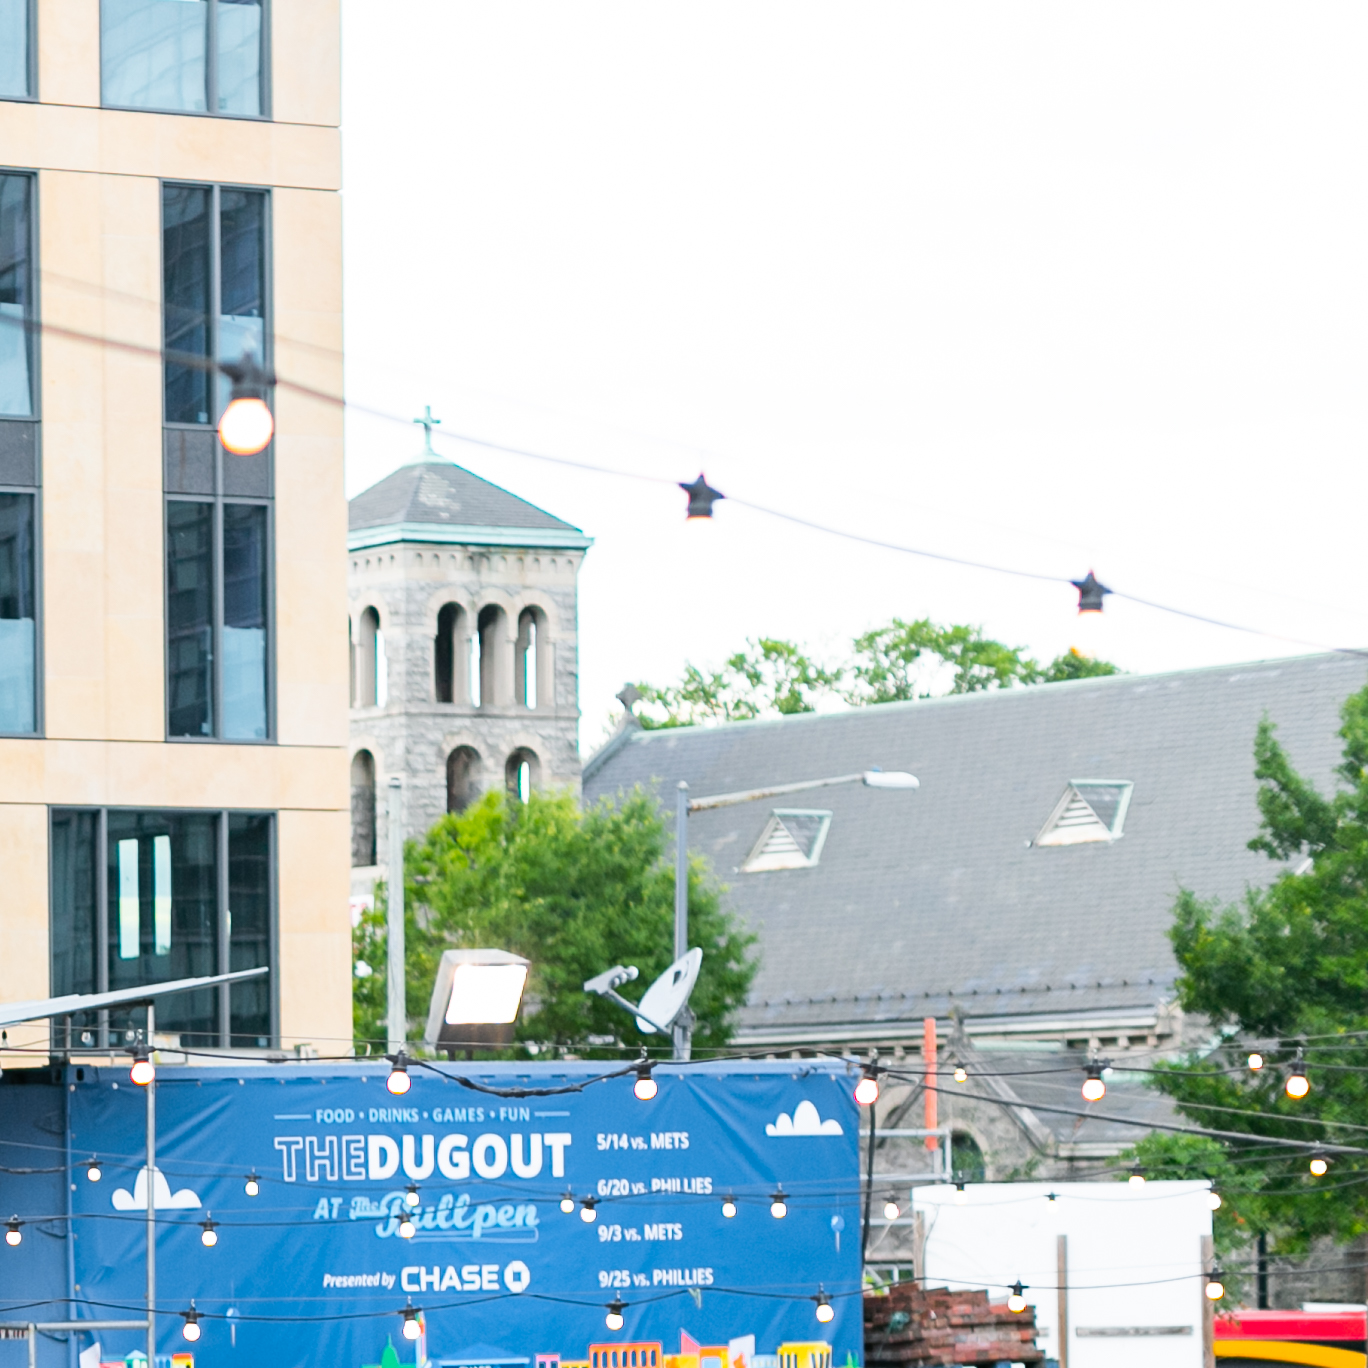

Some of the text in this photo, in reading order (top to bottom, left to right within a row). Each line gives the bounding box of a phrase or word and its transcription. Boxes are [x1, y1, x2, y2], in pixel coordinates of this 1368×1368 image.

[316, 1107, 530, 1124] FOOD DRINKS GAMES FUN
[597, 1132, 690, 1151] 5/14 vs. METS
[597, 1177, 713, 1196] 6/20 vs. PHILLIES
[314, 1197, 343, 1220] AT
[375, 1191, 540, 1240] Bullpen
[598, 1223, 683, 1242] 9/3 vs. METS
[322, 1265, 500, 1292] Presented by CHASE
[598, 1268, 714, 1288] 9/25 vs. PHILLIES
